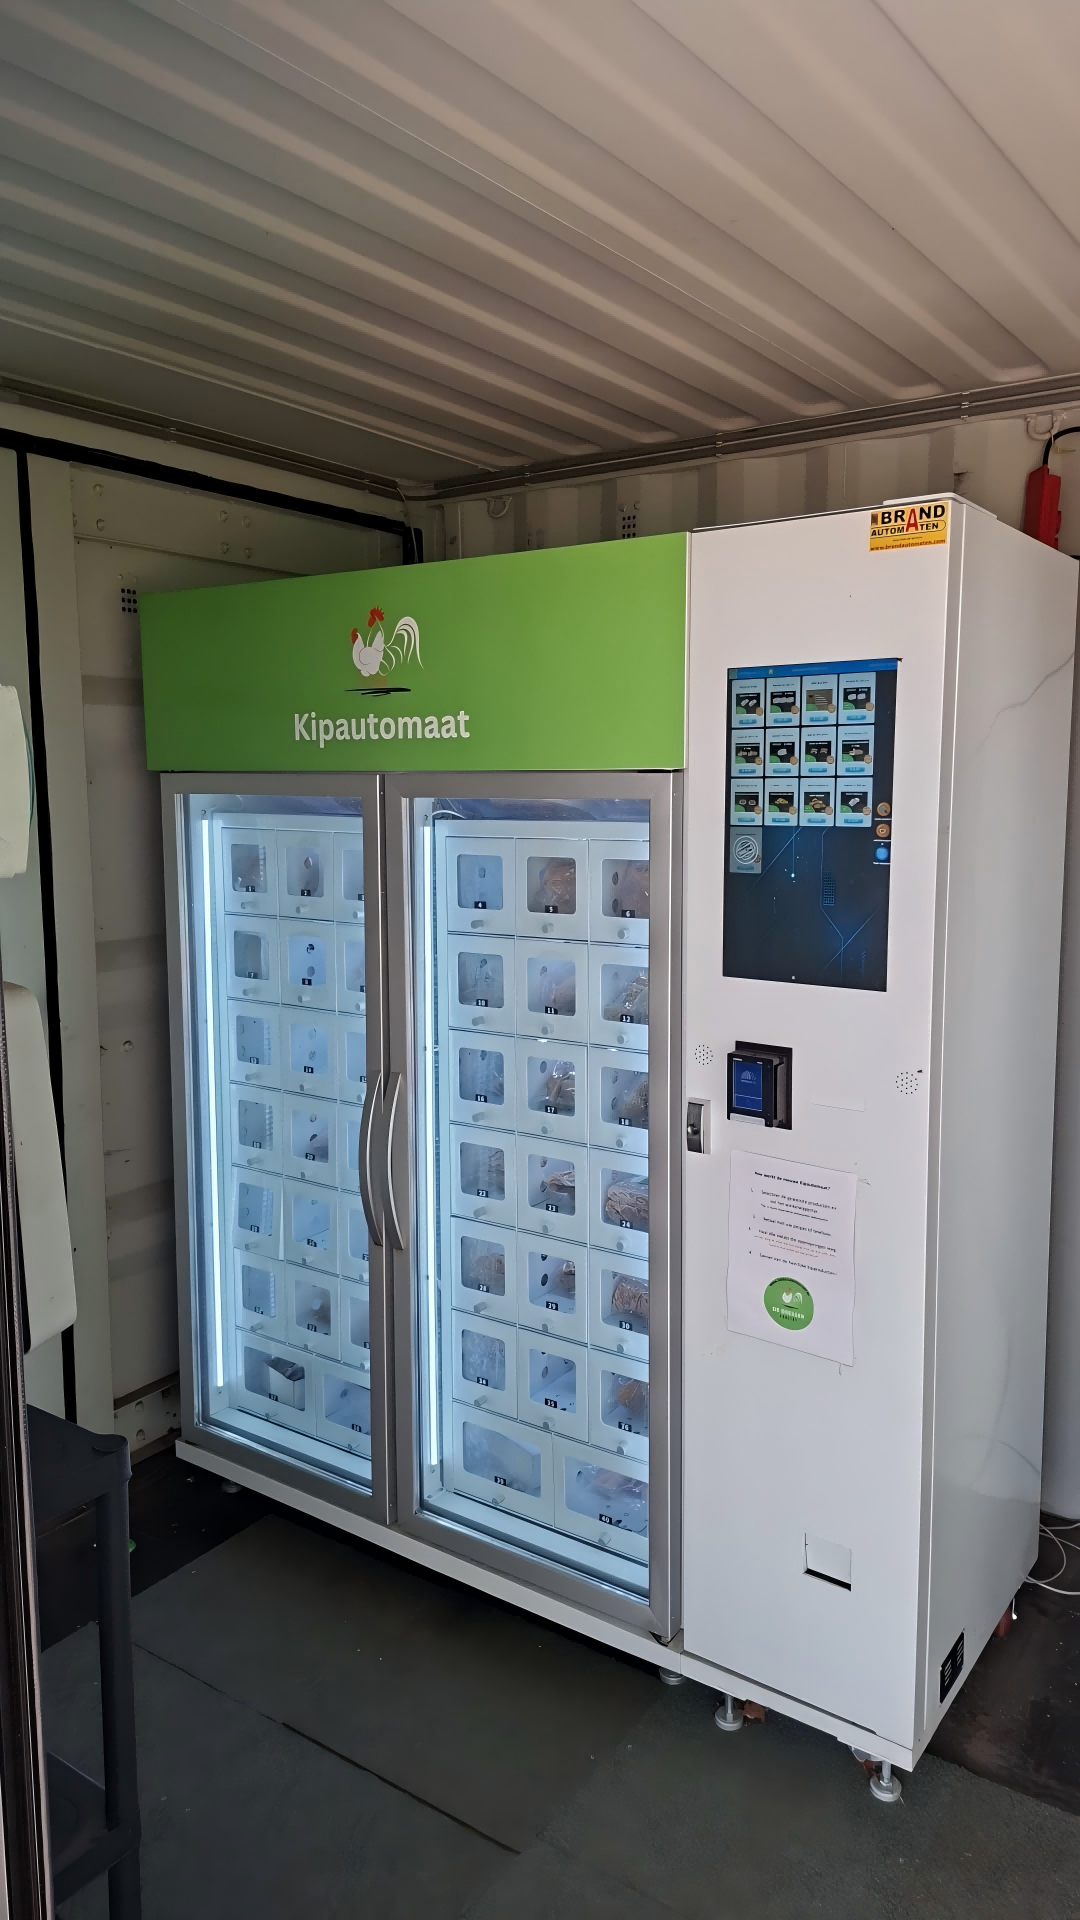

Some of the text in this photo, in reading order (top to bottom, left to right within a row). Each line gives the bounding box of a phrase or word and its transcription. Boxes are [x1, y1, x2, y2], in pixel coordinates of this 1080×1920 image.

[881, 504, 946, 527] BRAND
[871, 520, 939, 537] AUTOMATEN
[294, 710, 471, 749] Kipautomaat
